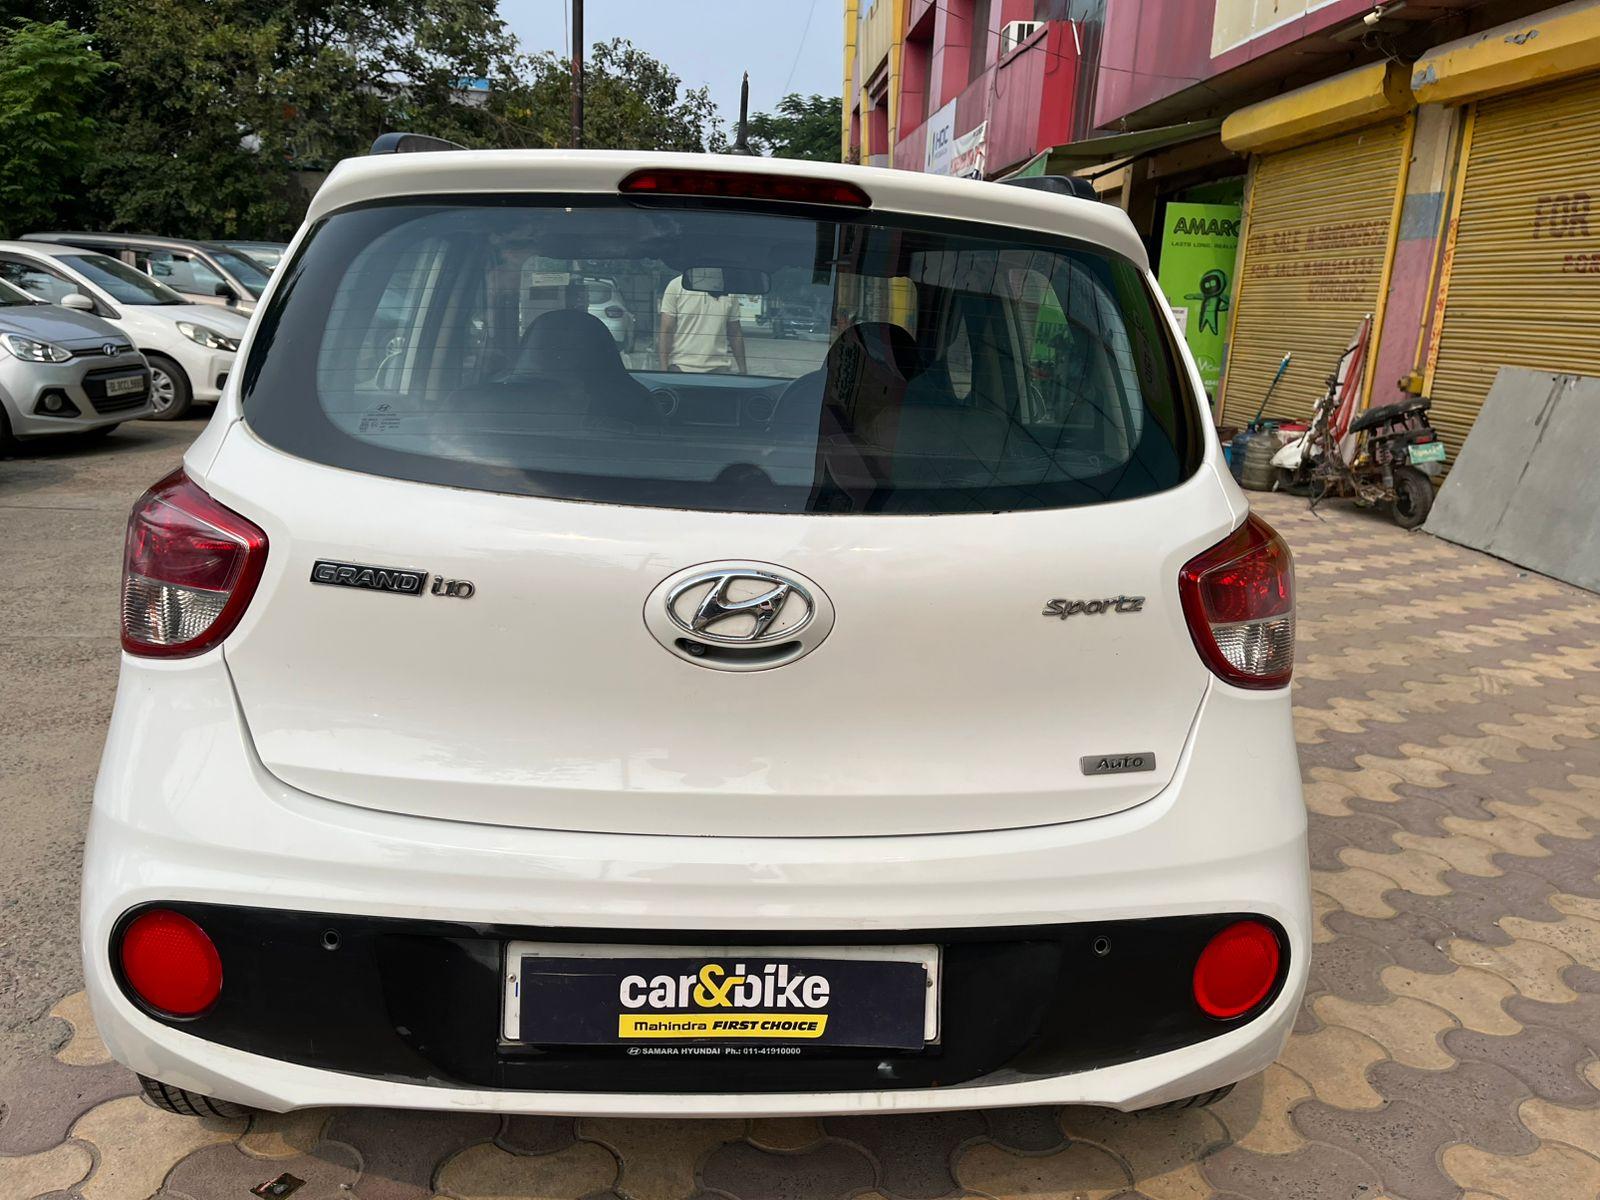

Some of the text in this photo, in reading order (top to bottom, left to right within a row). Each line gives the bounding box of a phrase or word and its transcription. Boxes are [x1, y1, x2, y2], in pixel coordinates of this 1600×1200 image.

[1533, 192, 1592, 239] FOR
[314, 563, 476, 599] GRAND i10
[1041, 595, 1146, 620] Sportz
[1096, 756, 1145, 770] Auto
[619, 963, 830, 1009] car&bike
[634, 1021, 818, 1031] Mahindra FIRST CHOICE
[642, 1047, 679, 1055] SAMARA
[681, 1047, 721, 1055] HYUNDAI
